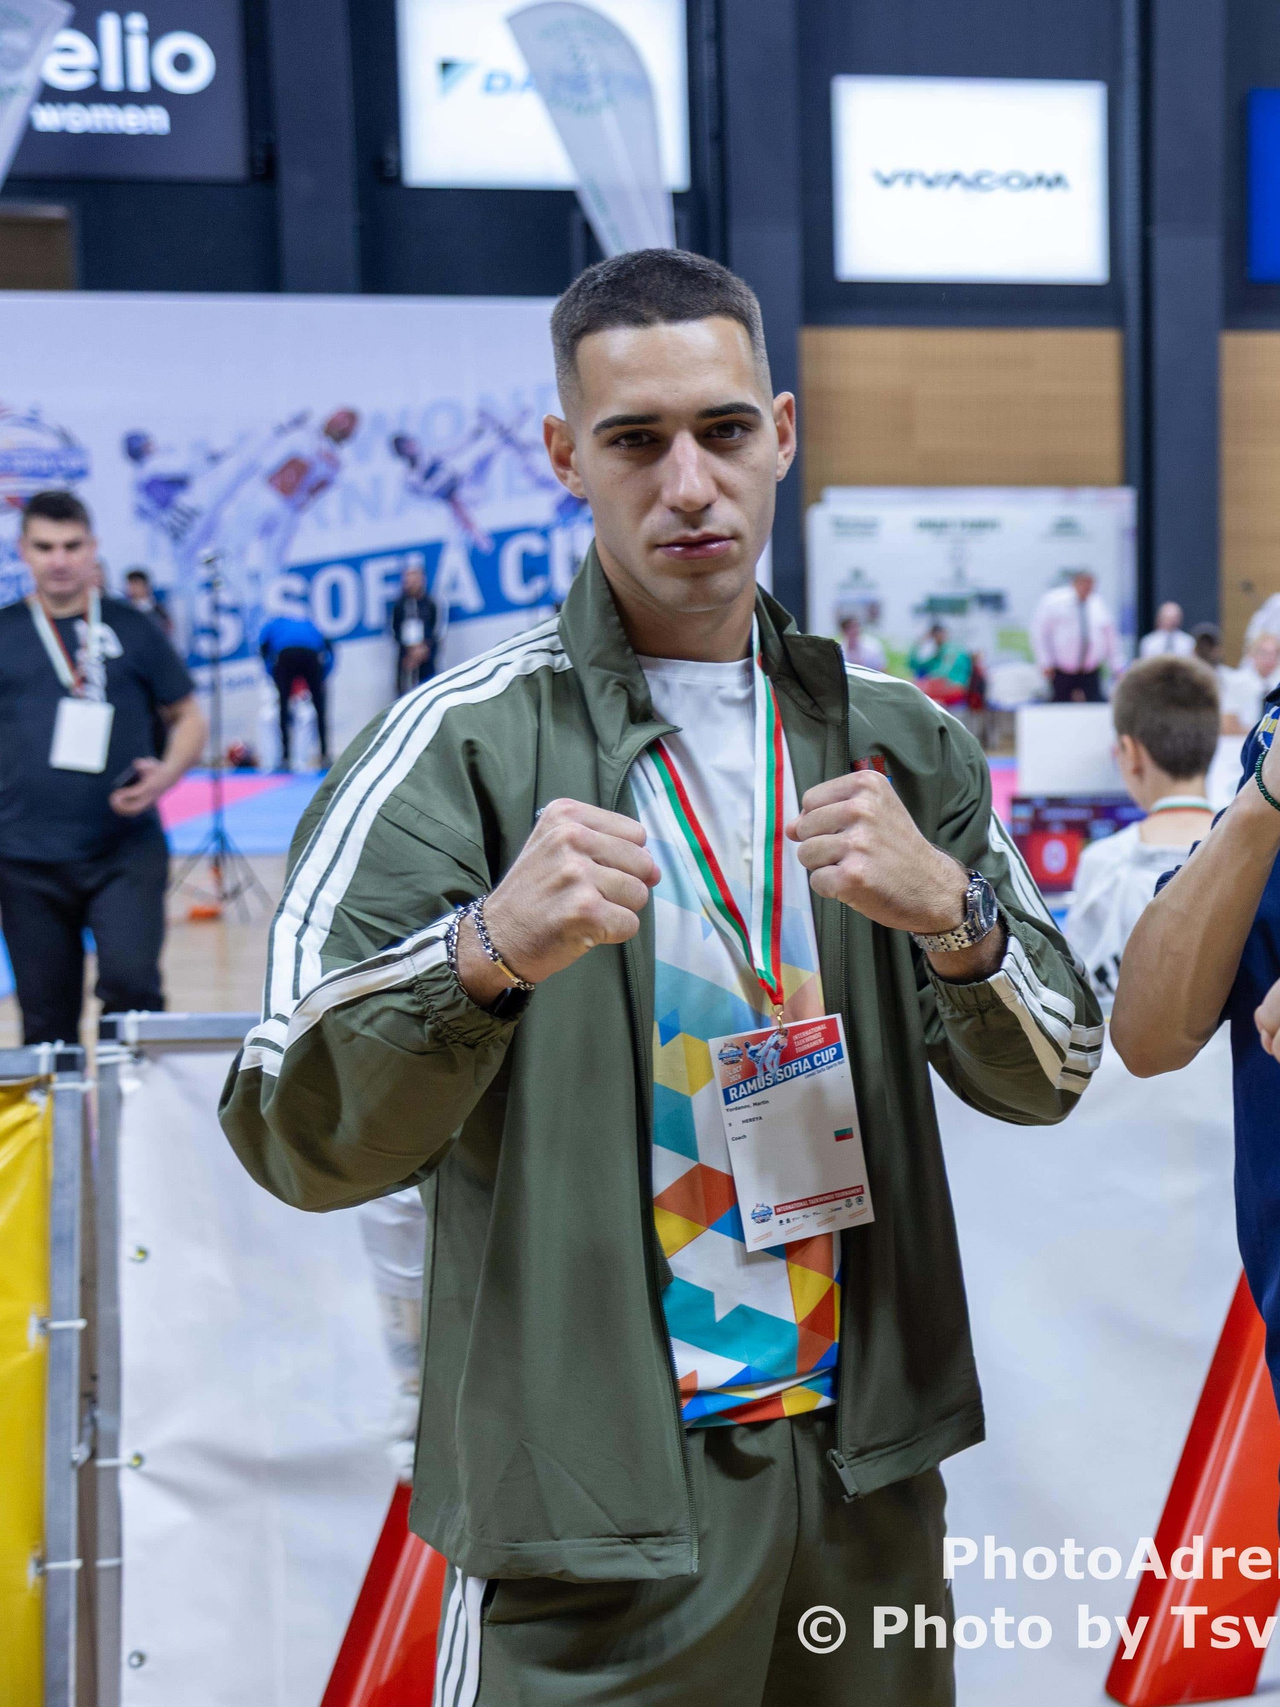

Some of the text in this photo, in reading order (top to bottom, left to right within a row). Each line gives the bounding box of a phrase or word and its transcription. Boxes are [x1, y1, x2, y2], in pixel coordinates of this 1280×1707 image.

[872, 168, 1070, 193] VIVACOM
[264, 541, 486, 638] SOFA
[728, 1047, 838, 1101] RAMUS SOFIA CUP
